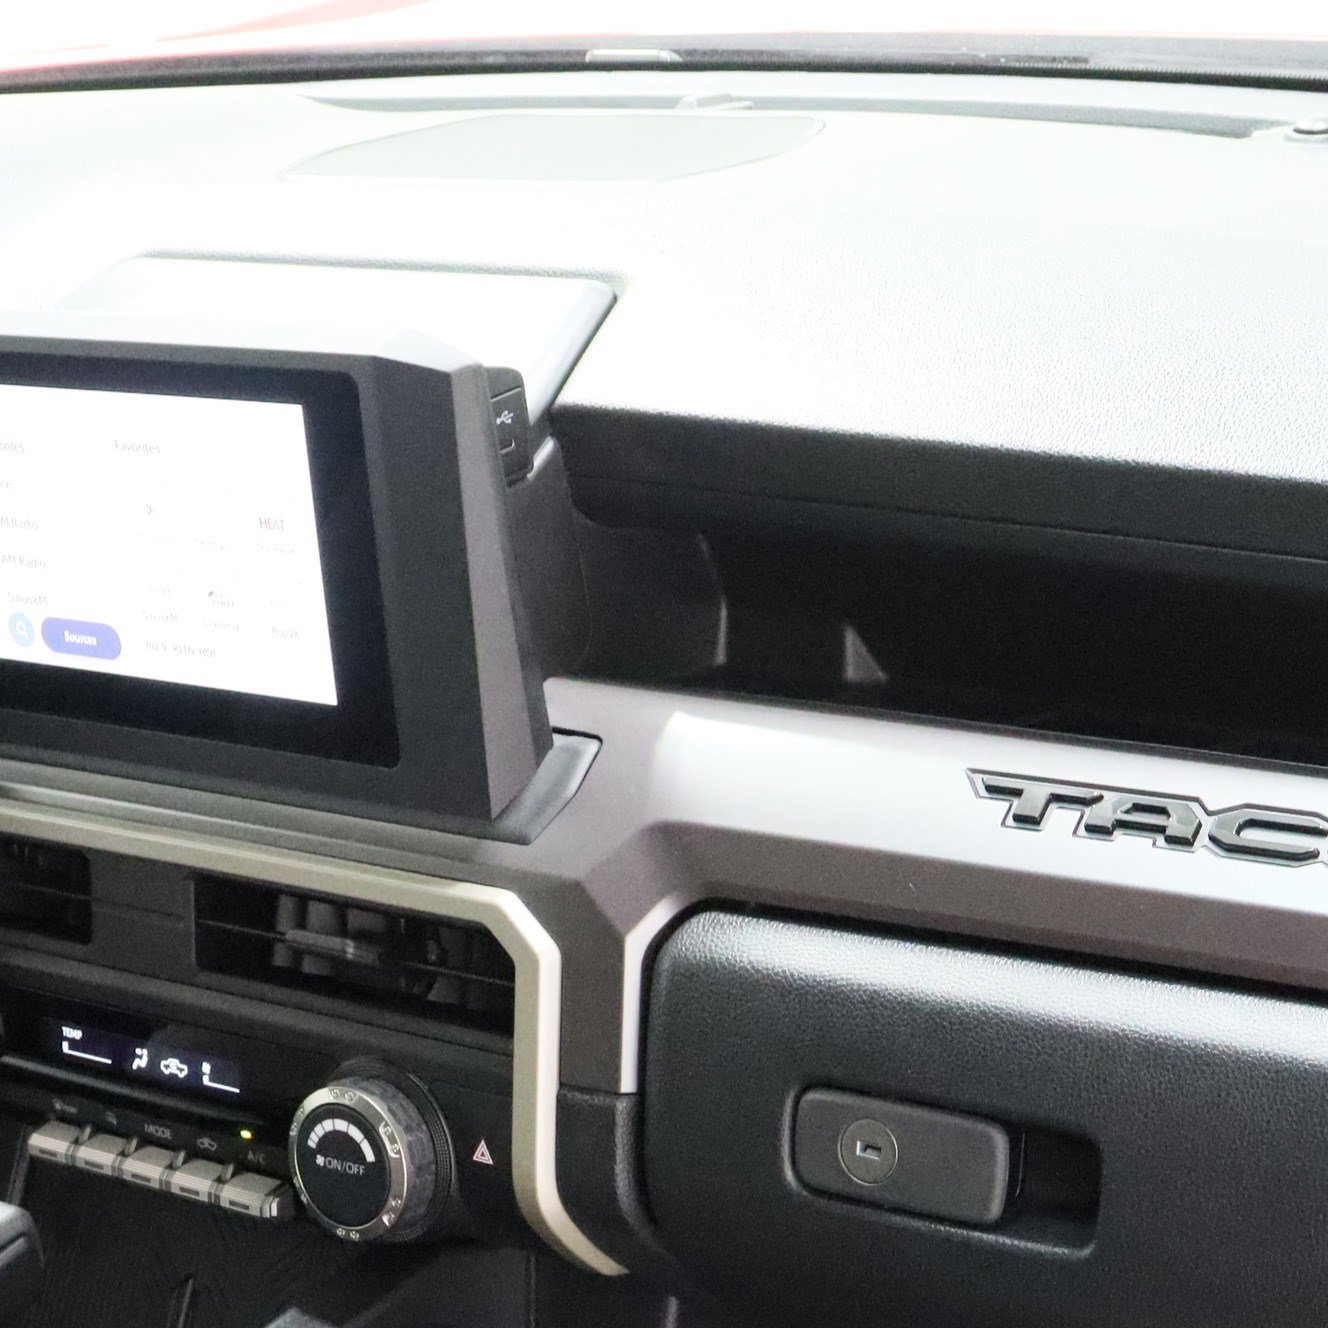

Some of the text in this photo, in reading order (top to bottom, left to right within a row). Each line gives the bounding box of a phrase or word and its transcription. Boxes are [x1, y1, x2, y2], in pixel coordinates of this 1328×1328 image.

[114, 439, 161, 455] Favorites
[11, 517, 40, 531] Radio
[258, 516, 285, 533] HEAT
[1, 554, 47, 569] AM Radio
[63, 630, 98, 646] Sources
[61, 1025, 84, 1041] TEMP
[144, 1122, 173, 1141] MODE
[247, 1149, 266, 1166] A/C
[325, 1156, 366, 1177] ON/OFF
